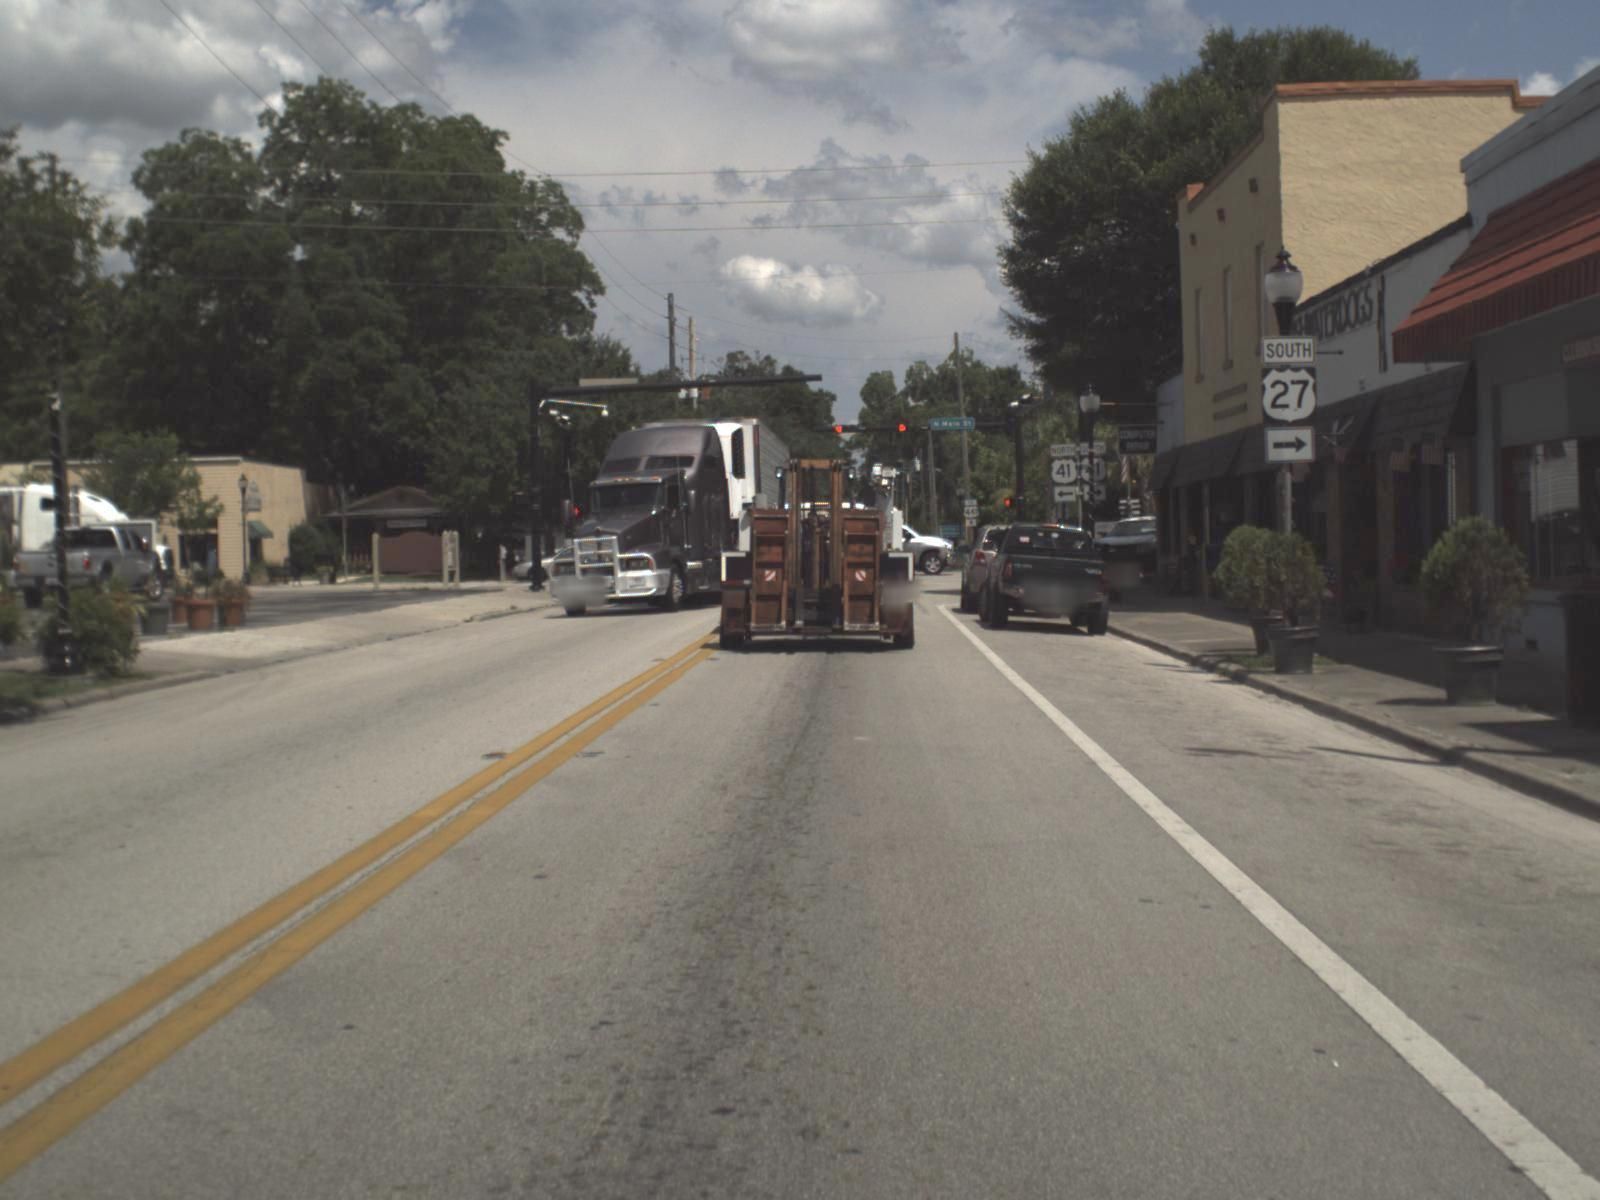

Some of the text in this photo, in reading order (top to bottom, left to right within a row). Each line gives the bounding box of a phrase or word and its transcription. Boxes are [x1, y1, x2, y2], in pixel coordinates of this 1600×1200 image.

[1266, 343, 1312, 359] SOUTH
[1270, 380, 1310, 409] 27
[1056, 463, 1071, 478] 41
